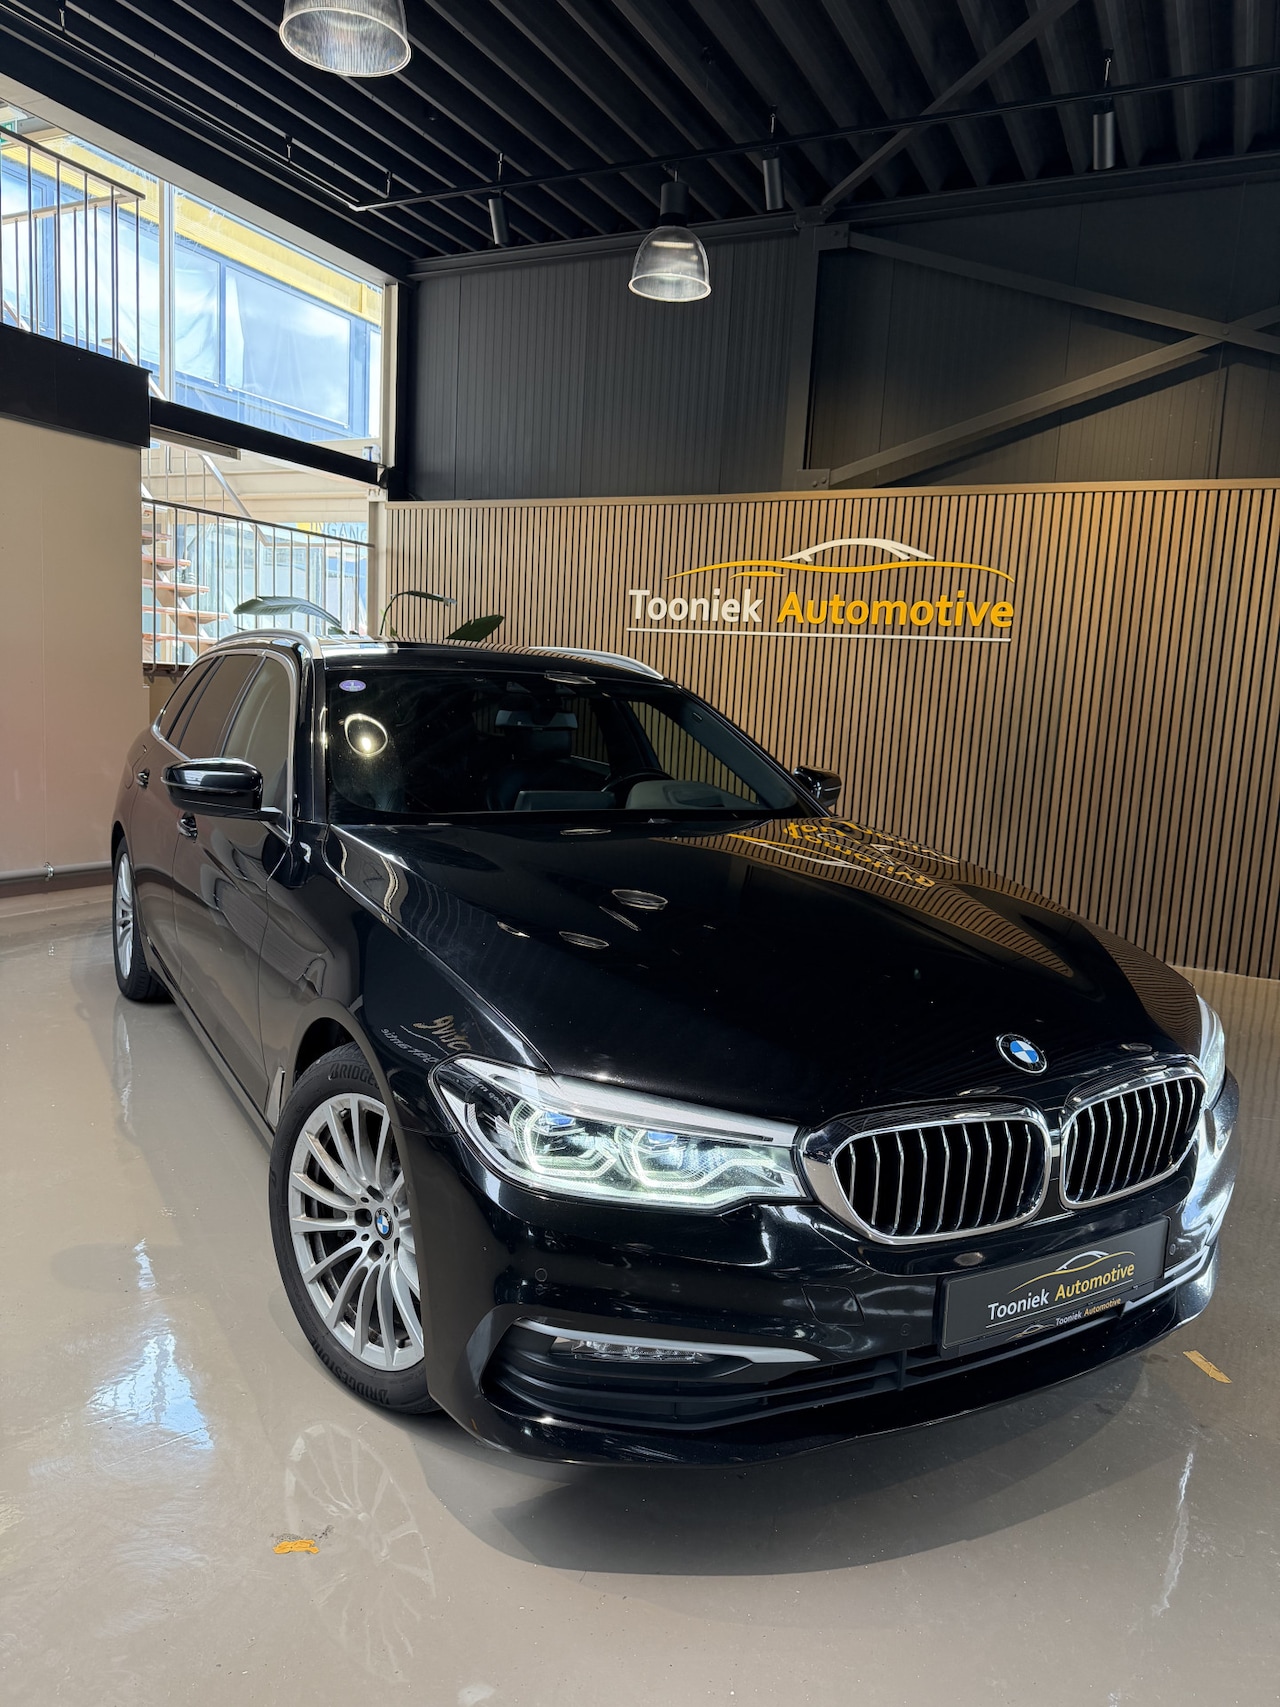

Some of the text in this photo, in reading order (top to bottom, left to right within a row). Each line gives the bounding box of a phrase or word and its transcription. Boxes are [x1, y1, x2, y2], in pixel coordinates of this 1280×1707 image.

[628, 588, 1014, 628] Tooniek Automotive
[987, 1262, 1135, 1321] Tooniek Automotive
[1055, 1297, 1121, 1326] Tooniek Automotive
